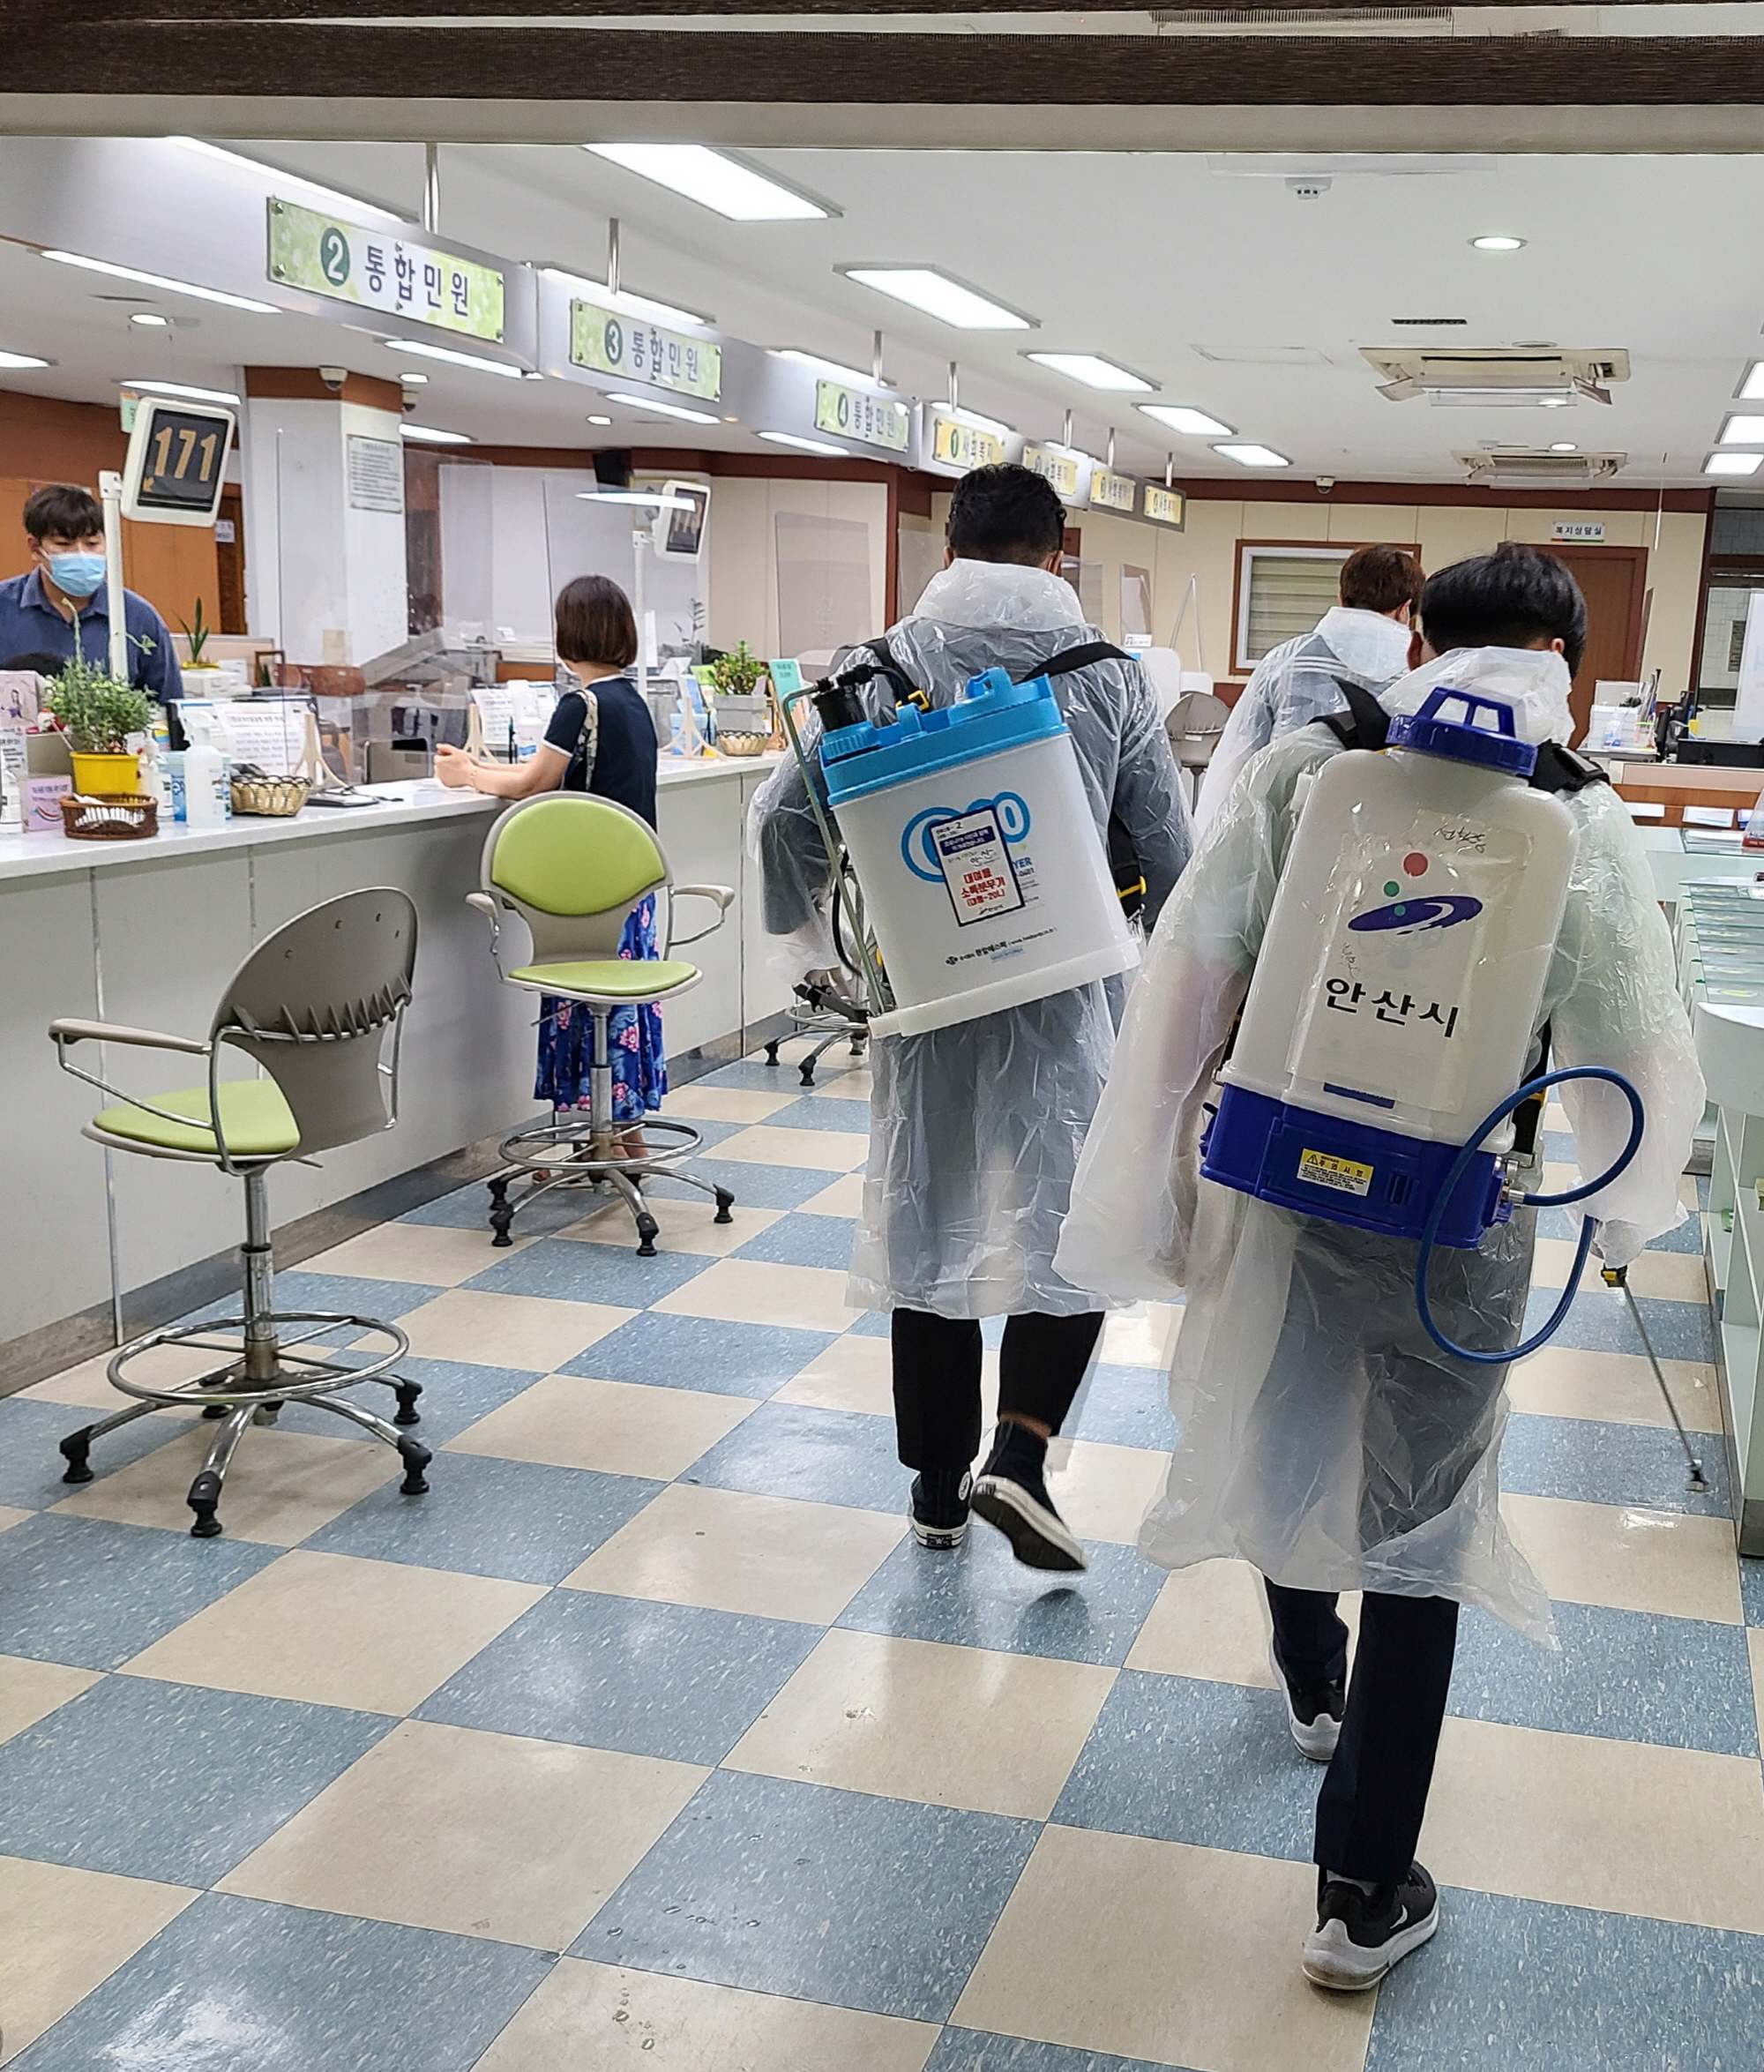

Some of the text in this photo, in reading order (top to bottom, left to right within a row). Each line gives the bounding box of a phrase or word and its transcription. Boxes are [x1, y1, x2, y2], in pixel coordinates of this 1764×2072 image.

[364, 244, 469, 318] 통합민원
[631, 331, 699, 384] 통합민원
[853, 400, 895, 438] 통합민원
[154, 425, 218, 482] 171
[1555, 526, 1602, 535] 복지상담실
[1012, 856, 1033, 870] YER
[1325, 977, 1460, 1038] 안산시
